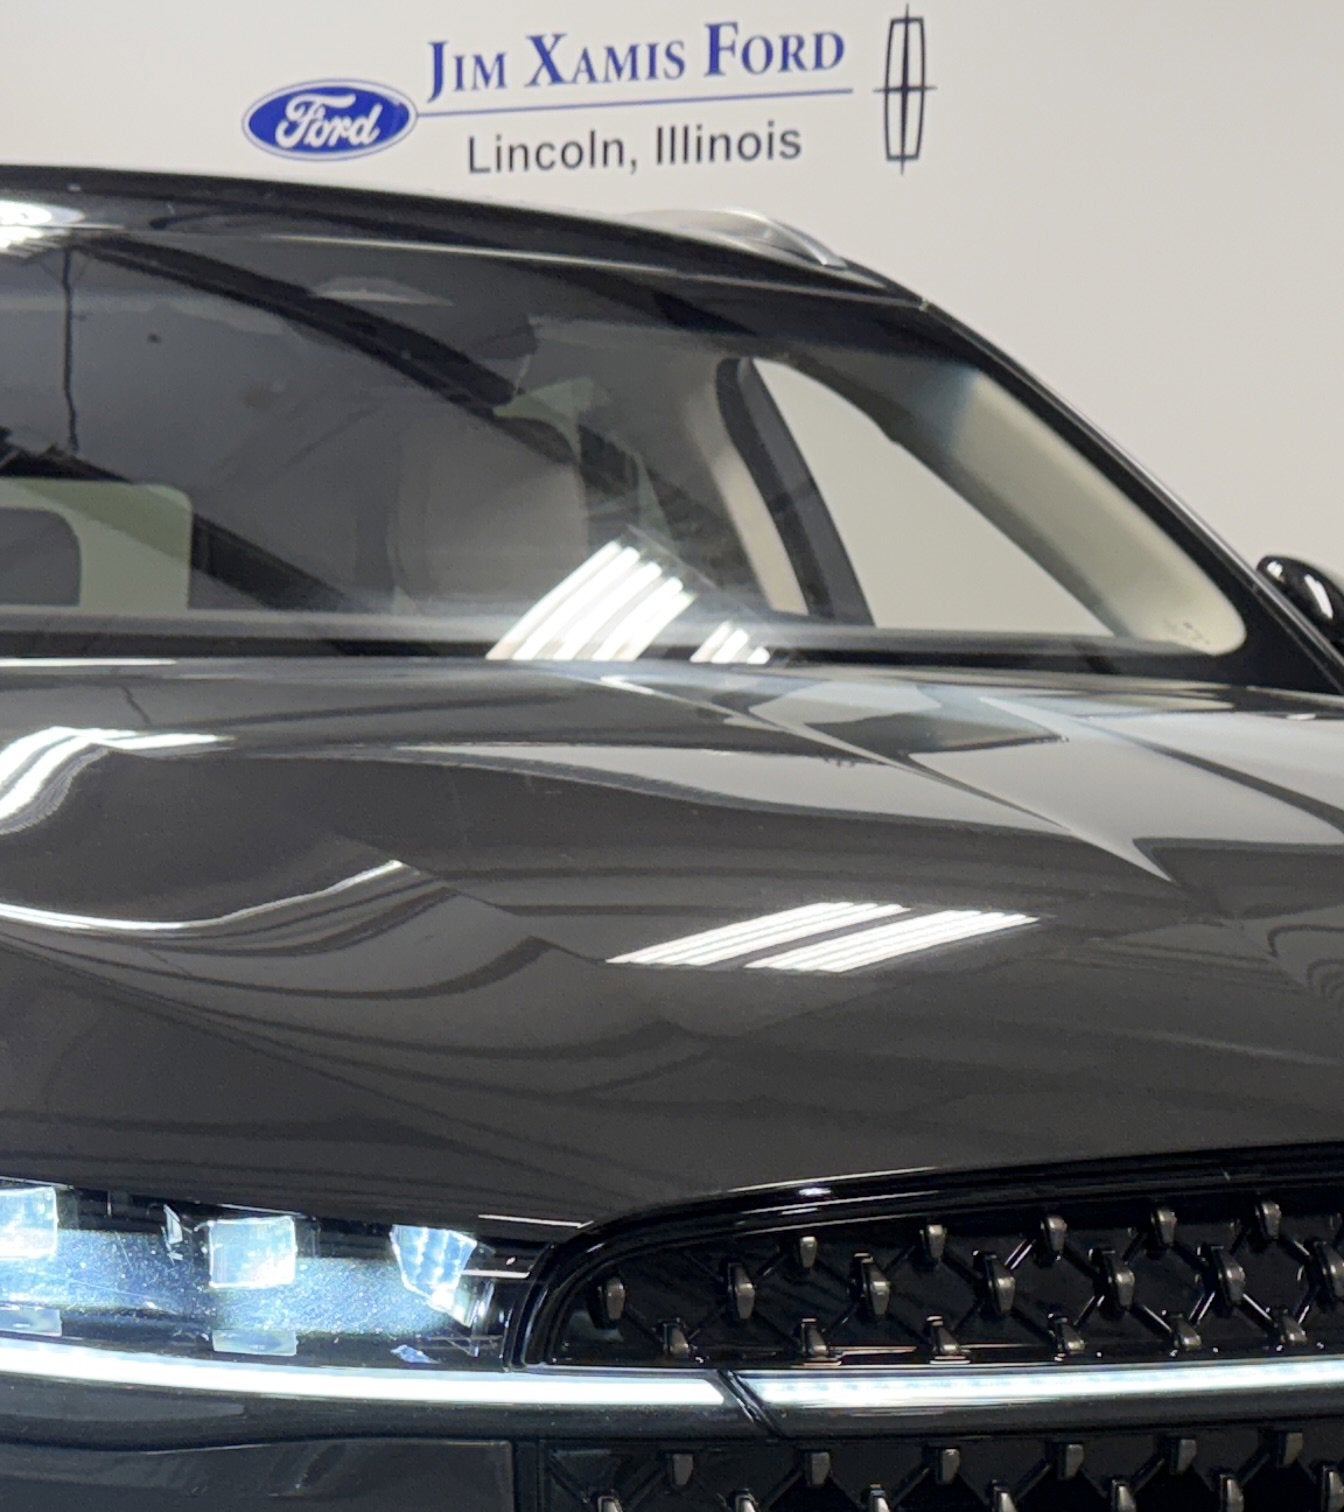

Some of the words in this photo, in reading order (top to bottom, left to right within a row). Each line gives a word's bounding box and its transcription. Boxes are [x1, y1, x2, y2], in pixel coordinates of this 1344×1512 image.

[427, 40, 507, 102] JIM
[525, 32, 686, 88] XAMIS
[703, 21, 846, 77] FORD
[275, 92, 380, 151] Ford
[467, 128, 639, 175] Lincoln,
[656, 121, 802, 165] Illinois
